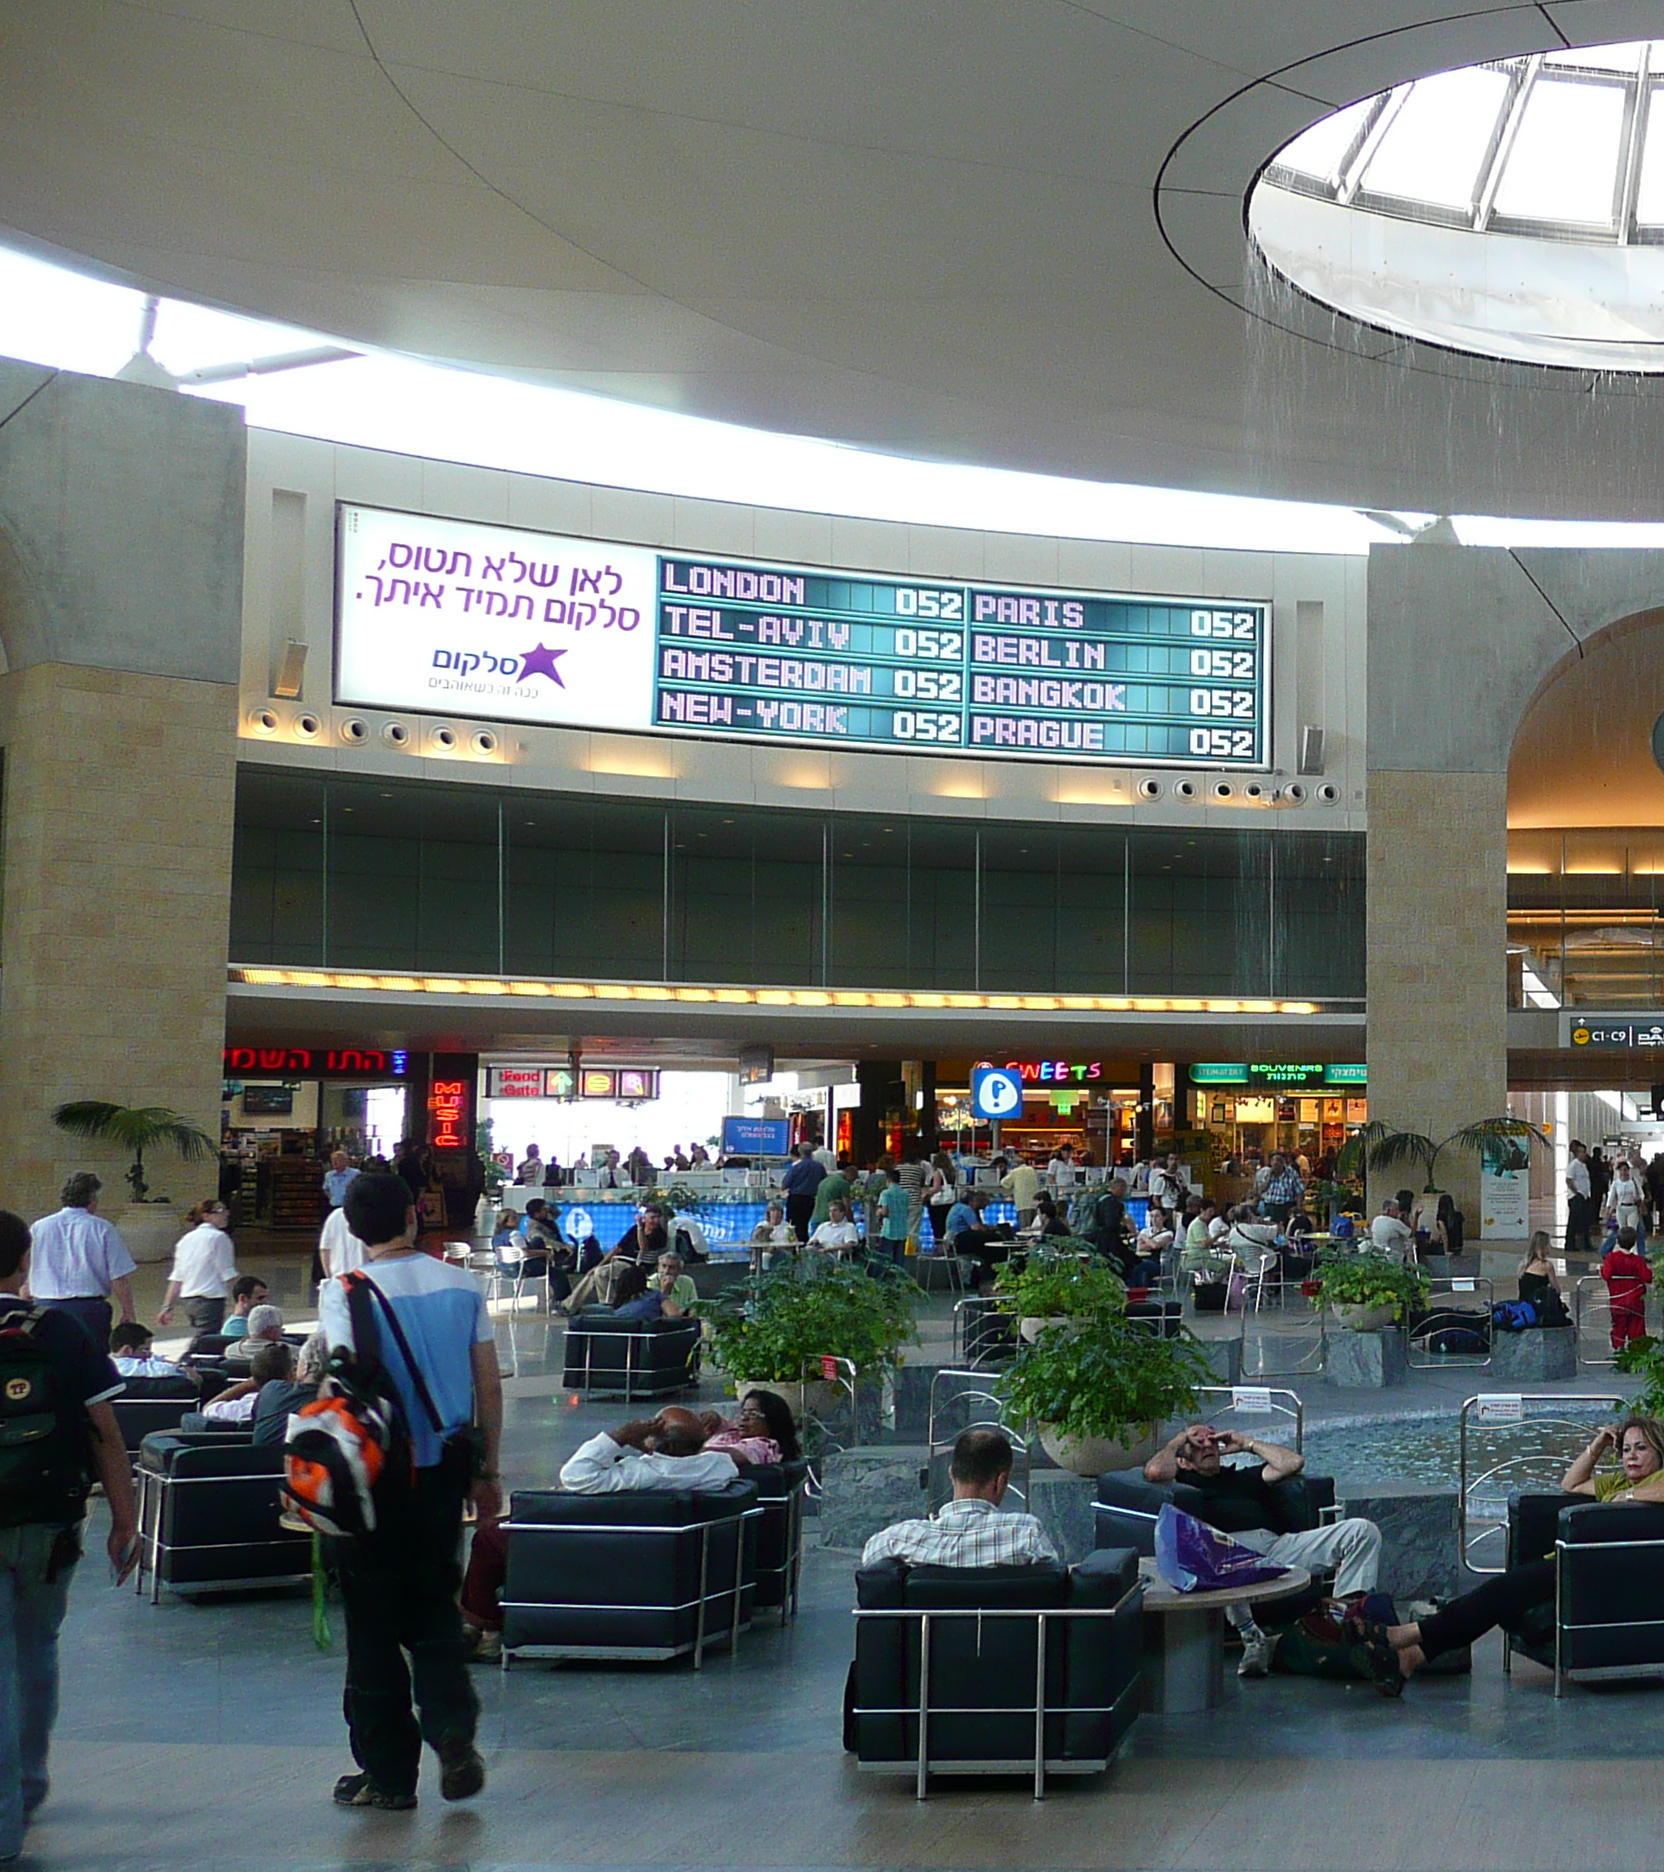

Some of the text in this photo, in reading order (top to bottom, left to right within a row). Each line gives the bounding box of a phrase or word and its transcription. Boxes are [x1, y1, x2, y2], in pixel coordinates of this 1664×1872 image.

[377, 542, 623, 597] לאן שלא תטוס,
[455, 586, 535, 620] תמיד
[665, 563, 962, 621] LONDON 052
[543, 598, 641, 631] סלקום
[664, 606, 962, 661] TEL-AVIV 052
[974, 595, 1254, 639] PARIS 052
[432, 650, 519, 677] סלקום
[663, 648, 962, 701] AMSTERDAM 052
[974, 634, 1253, 679] BERLIN 052
[661, 691, 961, 742] NEW-YORK 052
[973, 675, 1253, 718] BANGKOK 052
[972, 715, 1253, 757] PRAGUE 052
[326, 1049, 386, 1070] התו
